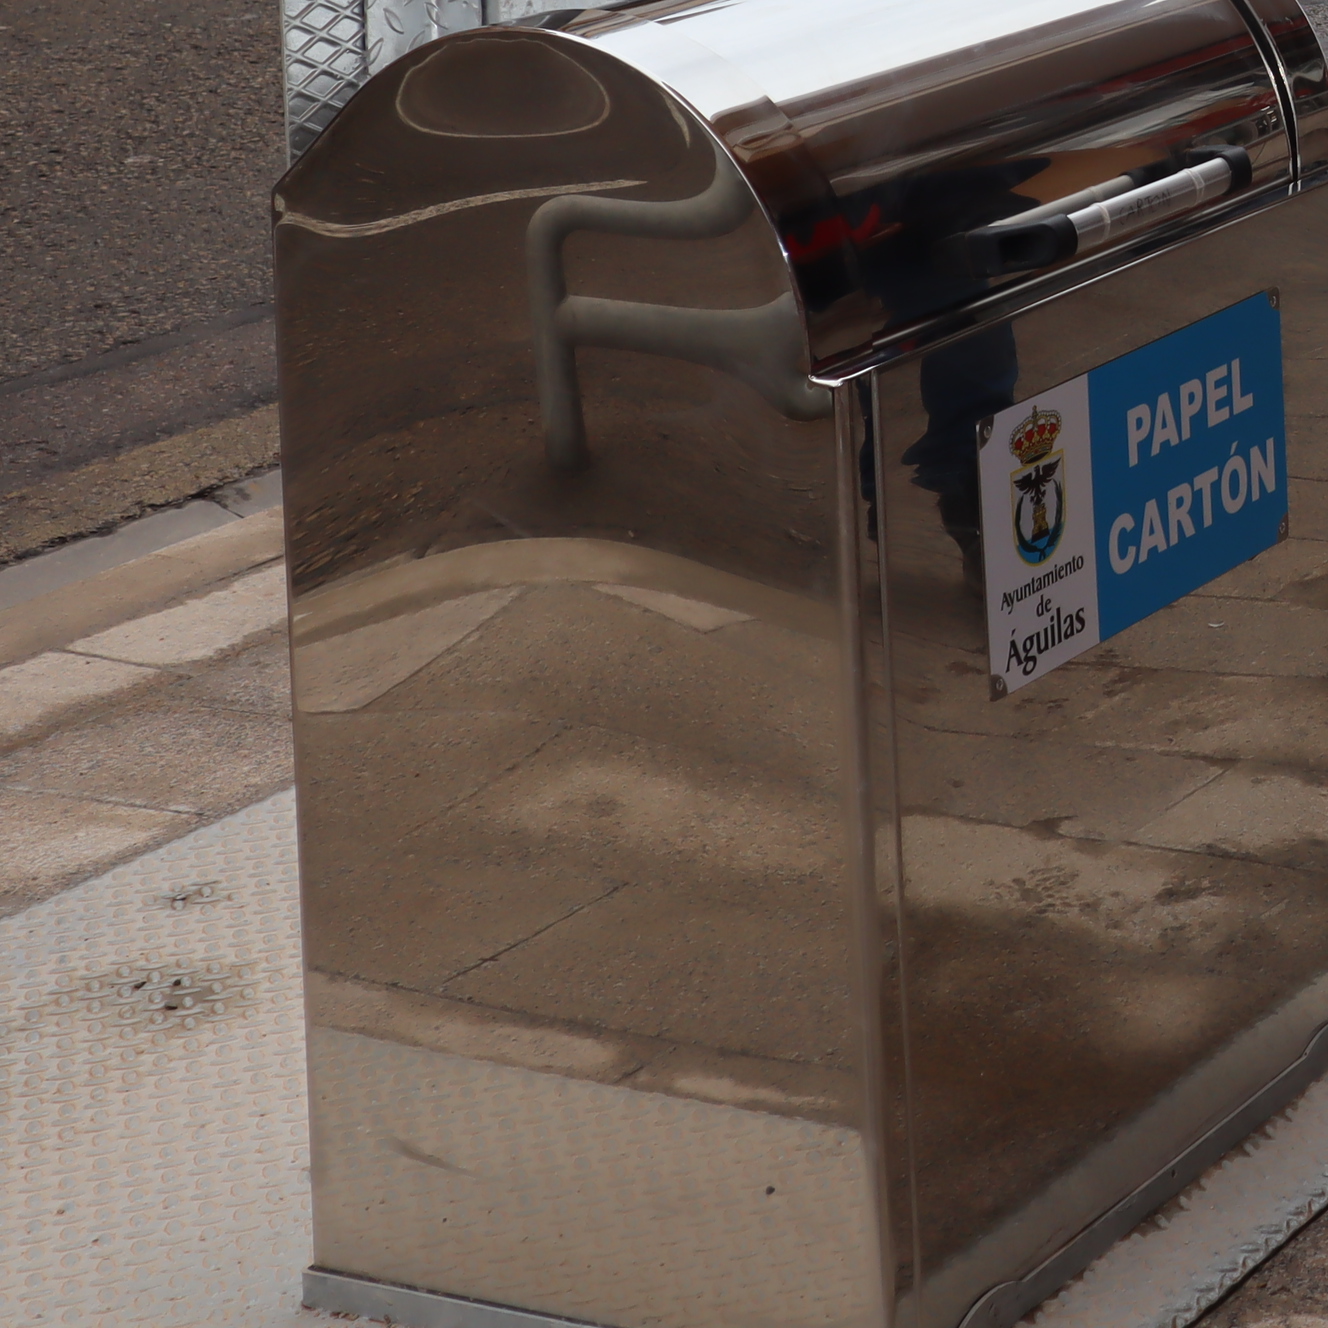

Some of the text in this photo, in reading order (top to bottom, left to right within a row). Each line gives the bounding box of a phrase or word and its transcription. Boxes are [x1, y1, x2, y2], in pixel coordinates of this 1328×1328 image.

[1126, 357, 1254, 468] PAPEL
[1108, 437, 1277, 575] CARTÓN
[1001, 555, 1085, 615] Ayuntamiento
[1036, 594, 1052, 618] de
[1005, 606, 1086, 677] Águilas
